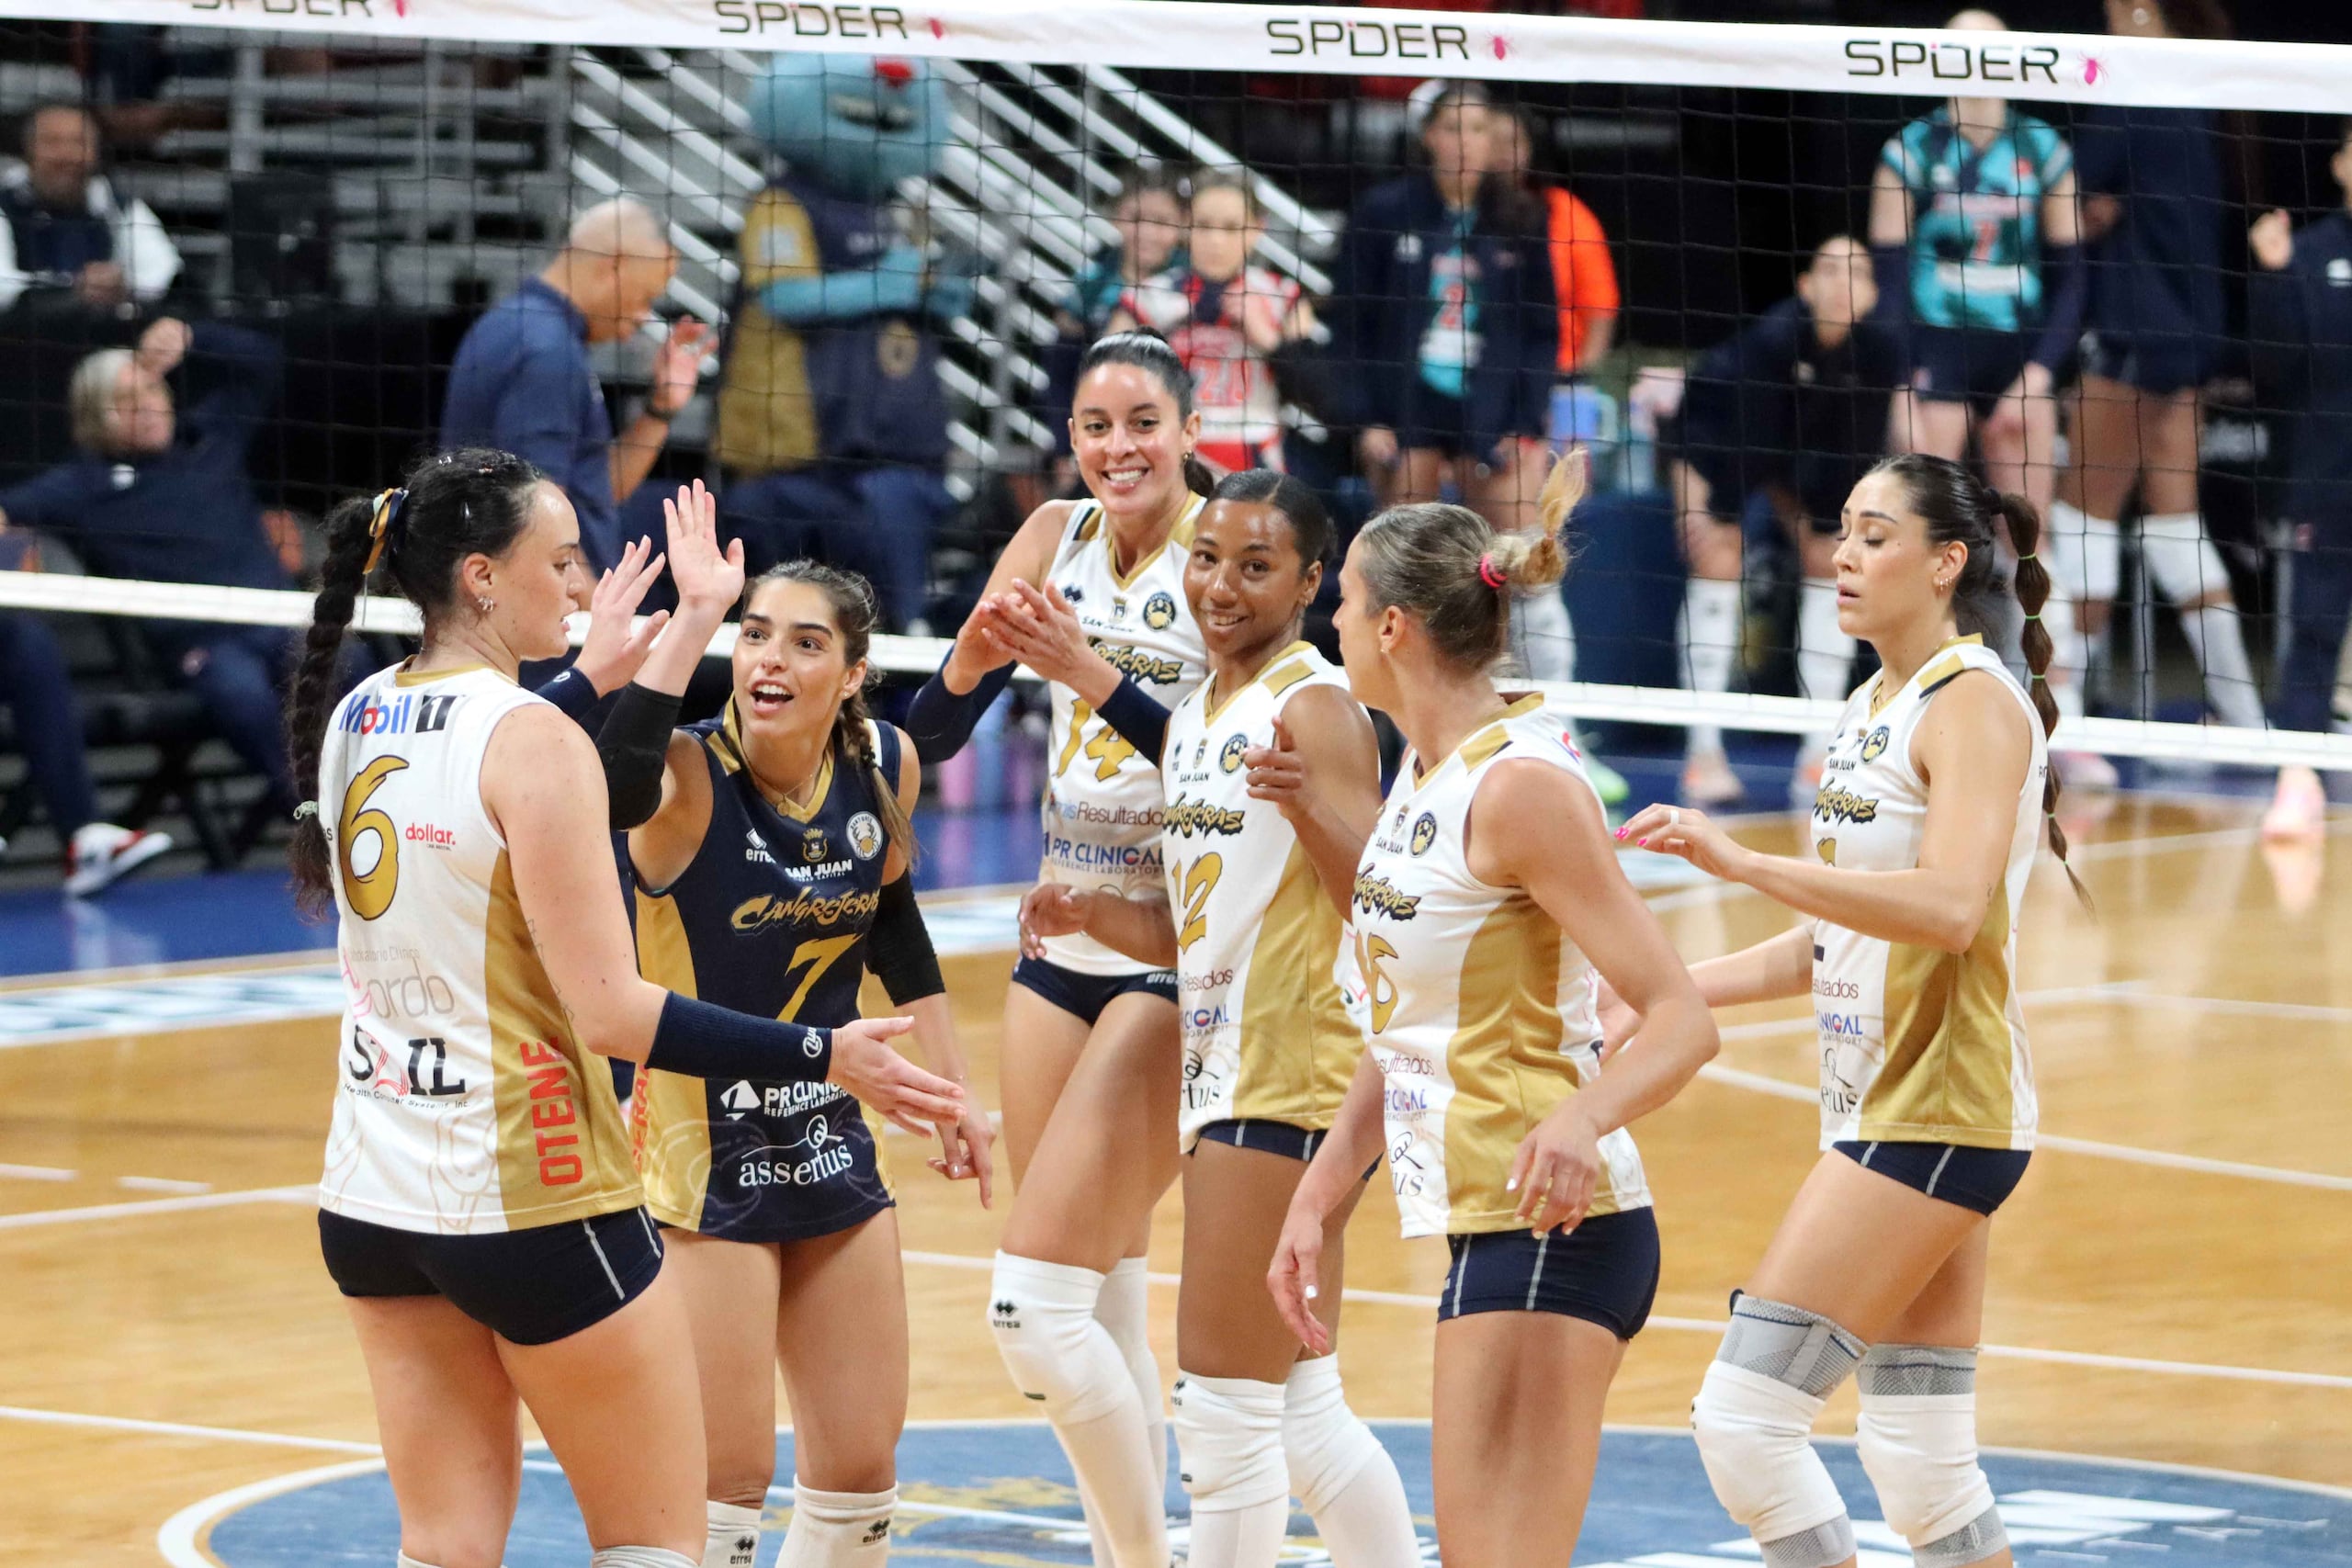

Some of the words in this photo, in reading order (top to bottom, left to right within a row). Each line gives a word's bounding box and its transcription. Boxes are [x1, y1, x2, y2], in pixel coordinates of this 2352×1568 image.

[338, 694, 413, 735] Mobil
[1057, 698, 1136, 782] 14
[338, 754, 410, 921] 6
[405, 823, 456, 845] dollar.
[814, 859, 854, 877] JUAN
[1171, 852, 1223, 955] 12
[775, 933, 865, 1023] 7
[763, 1100, 808, 1118] REFERENCE
[764, 1086, 791, 1109] PR
[739, 1144, 853, 1188] assertus
